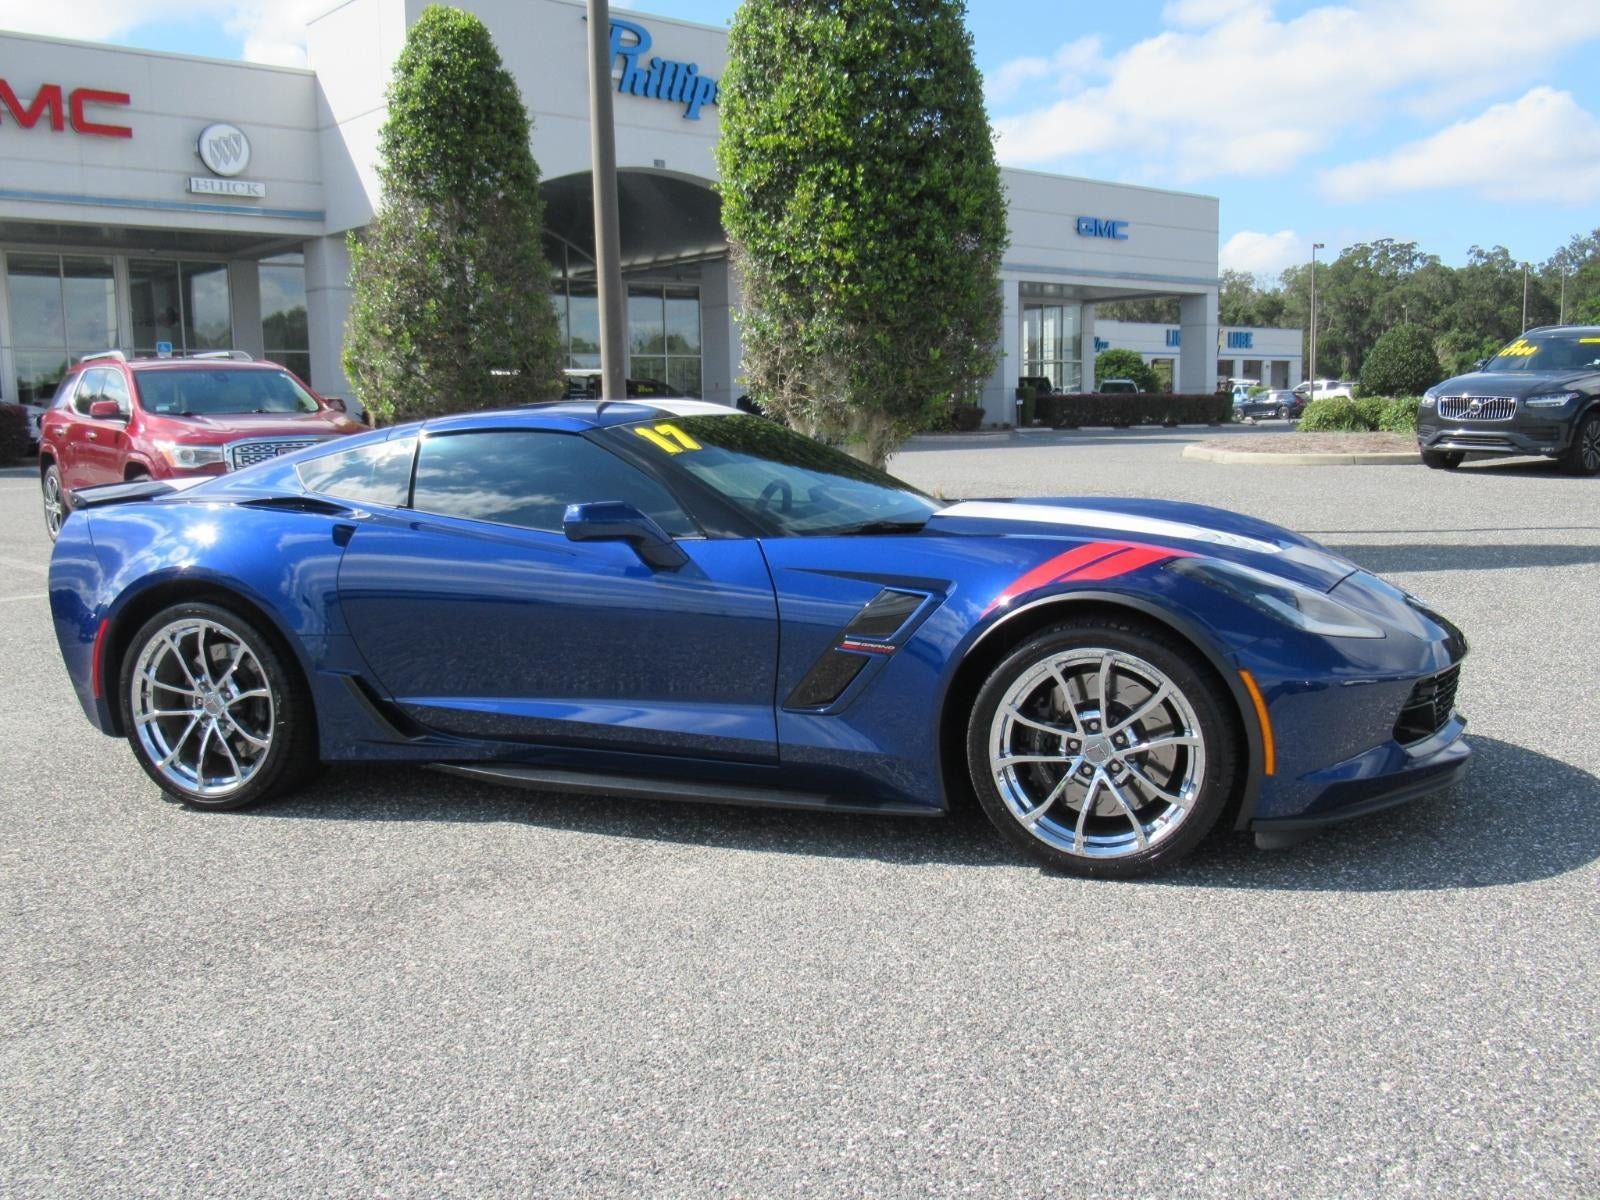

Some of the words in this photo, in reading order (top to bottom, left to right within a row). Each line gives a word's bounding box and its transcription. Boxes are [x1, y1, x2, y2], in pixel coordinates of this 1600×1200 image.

[608, 18, 722, 120] Phillip
[194, 179, 259, 196] BUICK
[1076, 216, 1129, 241] GMC
[1227, 331, 1254, 349] LUBE
[634, 424, 703, 454] 17
